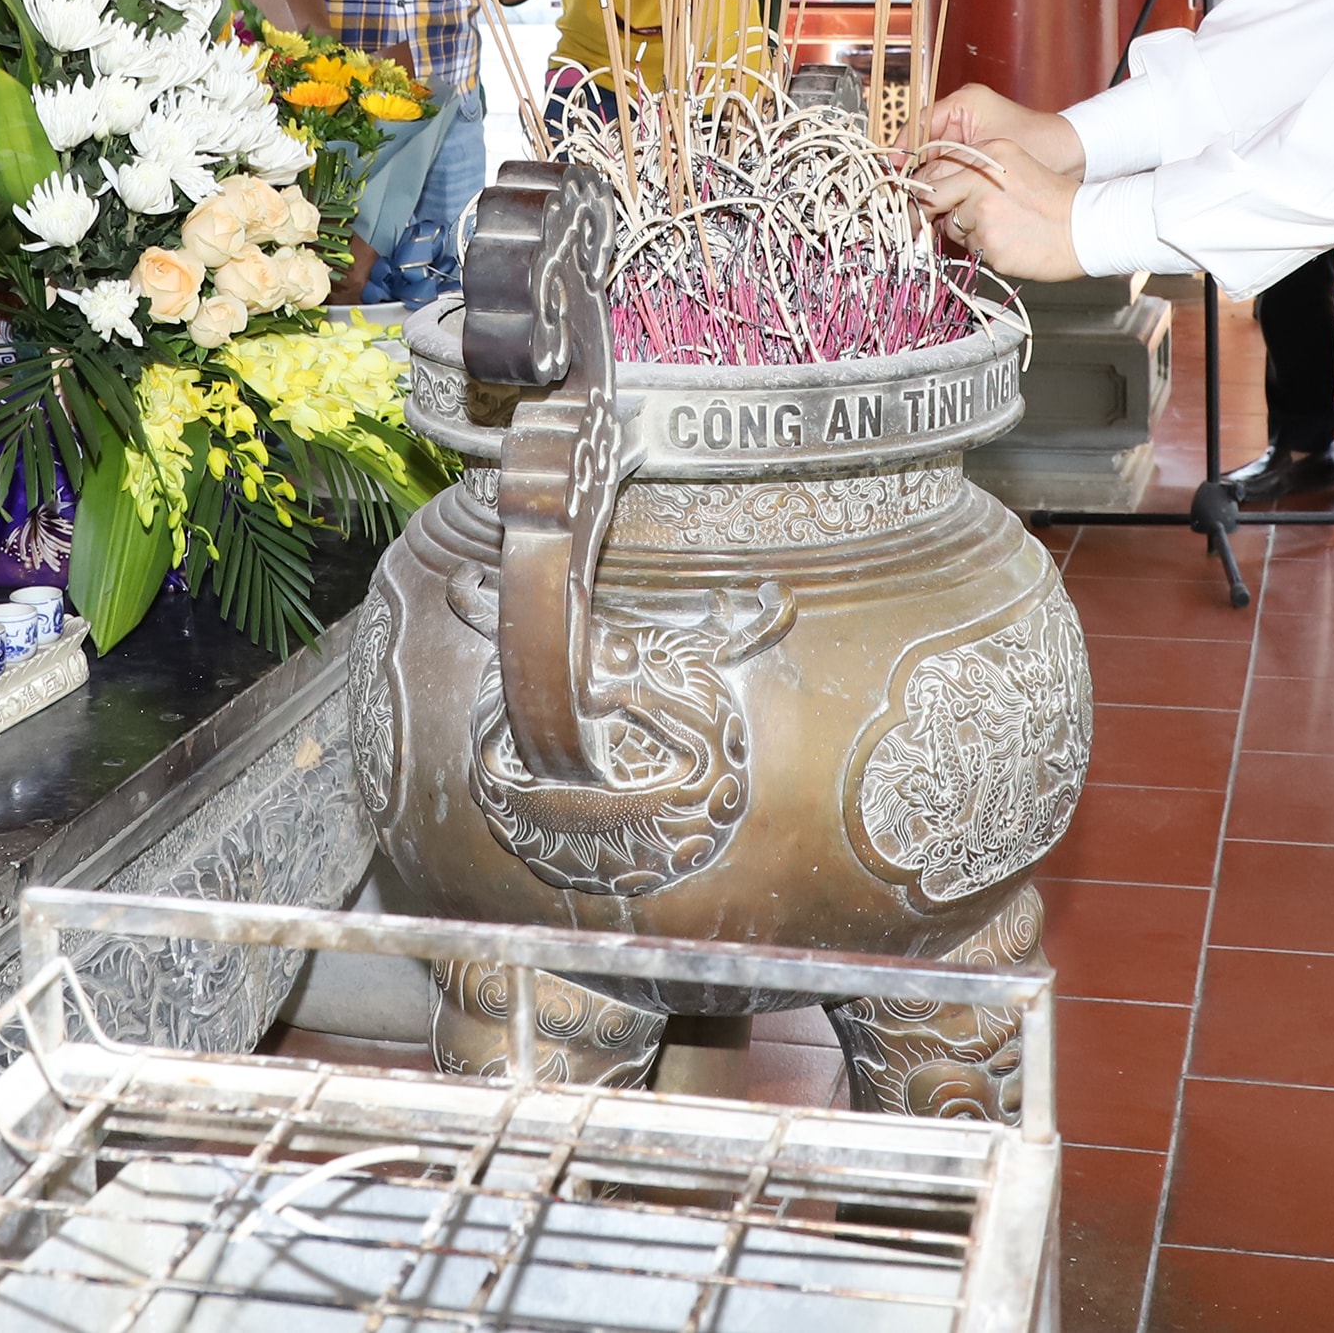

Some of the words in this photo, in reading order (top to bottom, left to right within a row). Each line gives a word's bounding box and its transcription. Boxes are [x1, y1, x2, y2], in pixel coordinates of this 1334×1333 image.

[669, 399, 803, 451] CÔNG
[825, 395, 884, 443] AN
[903, 377, 975, 434] TỈNH
